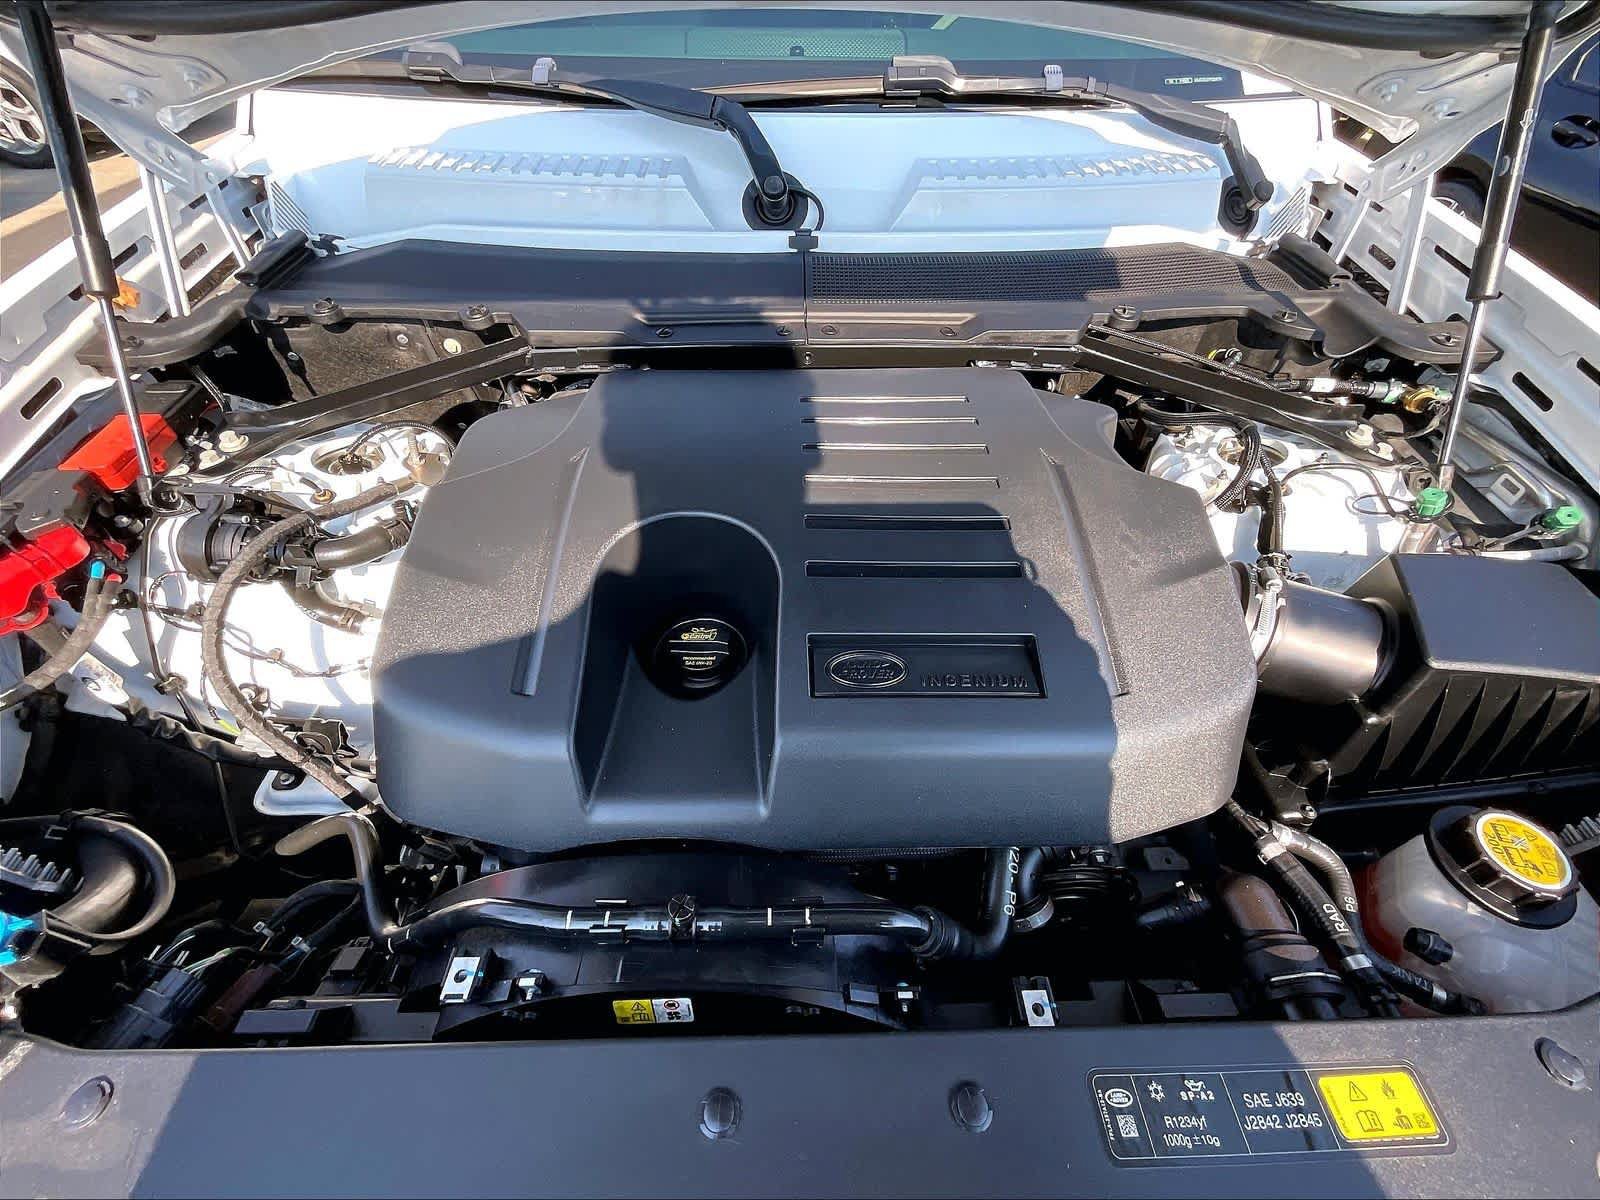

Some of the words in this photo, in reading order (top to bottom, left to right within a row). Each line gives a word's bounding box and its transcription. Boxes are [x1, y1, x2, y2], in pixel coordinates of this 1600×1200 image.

[920, 672, 1029, 688] INGENIUM
[1322, 903, 1350, 933] RAD
[1242, 1093, 1273, 1109] SAE
[1274, 1091, 1305, 1108] J639
[1163, 1115, 1208, 1131] R1234yf
[1244, 1115, 1283, 1131] J2842
[1284, 1112, 1323, 1129] J2845
